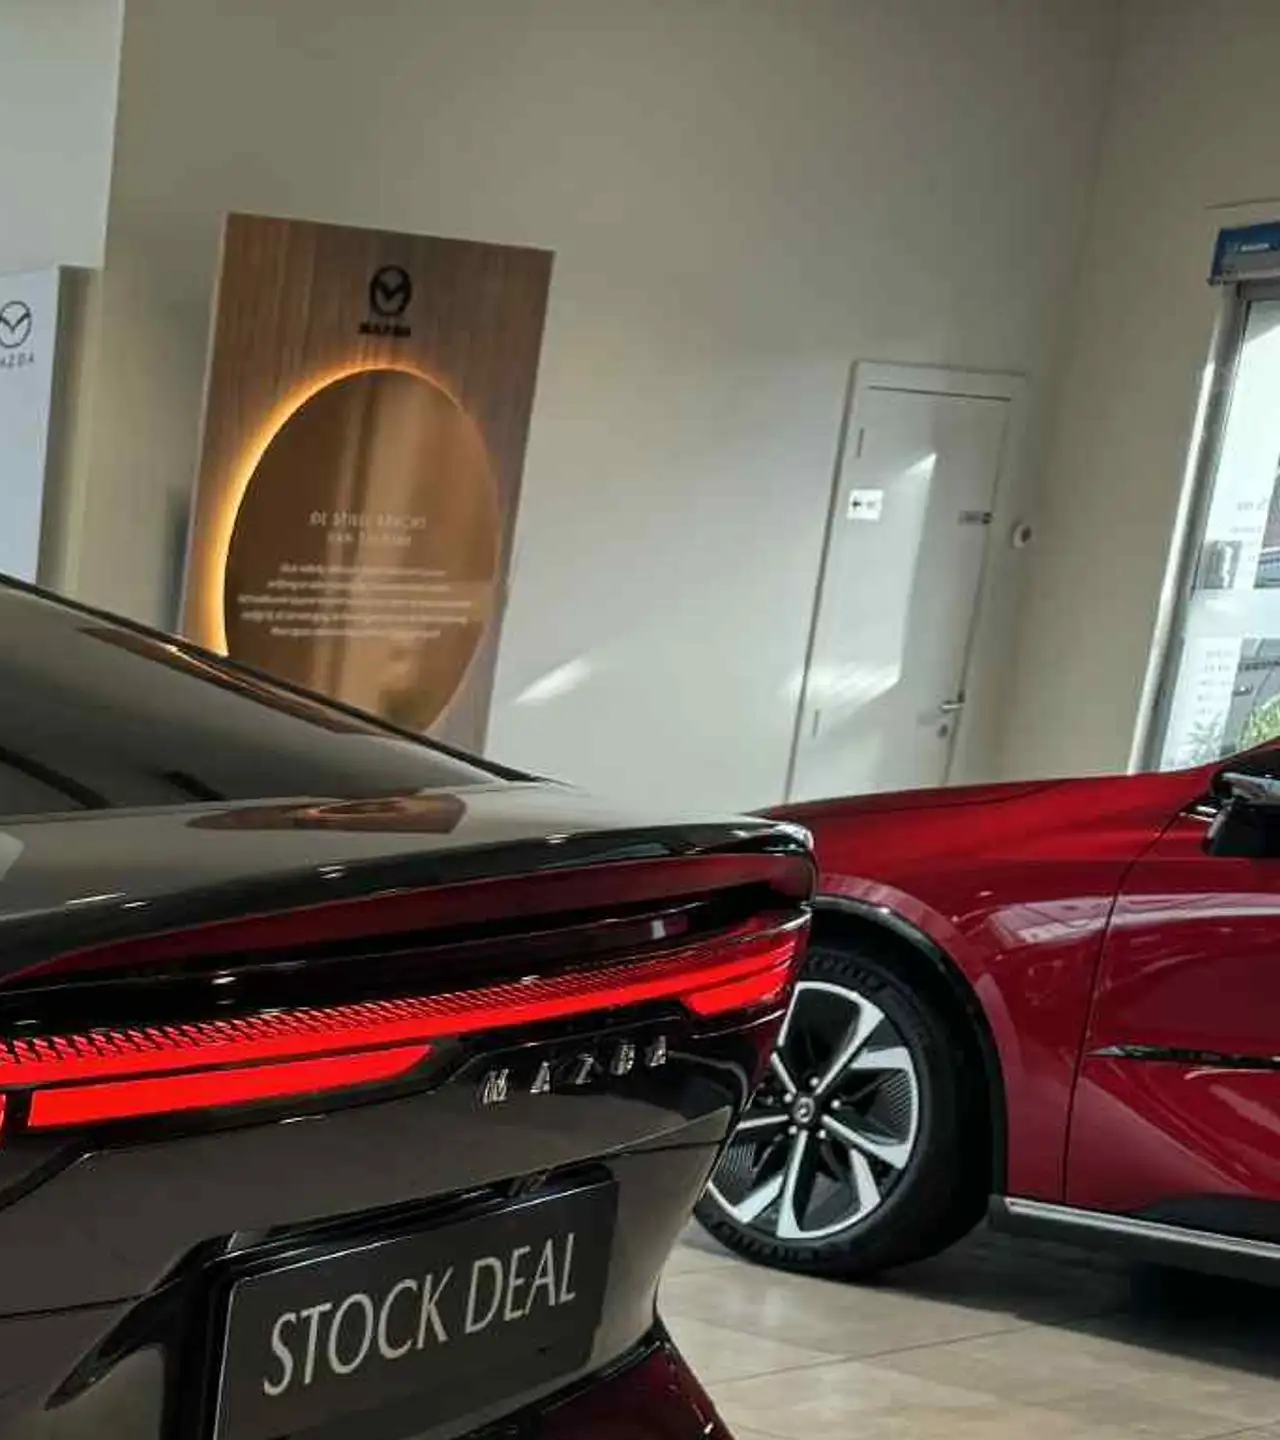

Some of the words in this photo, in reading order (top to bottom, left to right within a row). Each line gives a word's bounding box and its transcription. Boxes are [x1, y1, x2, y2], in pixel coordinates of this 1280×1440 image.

[482, 1035, 667, 1104] MAZDA
[262, 1266, 456, 1396] STOCK
[465, 1232, 577, 1335] DEAL
